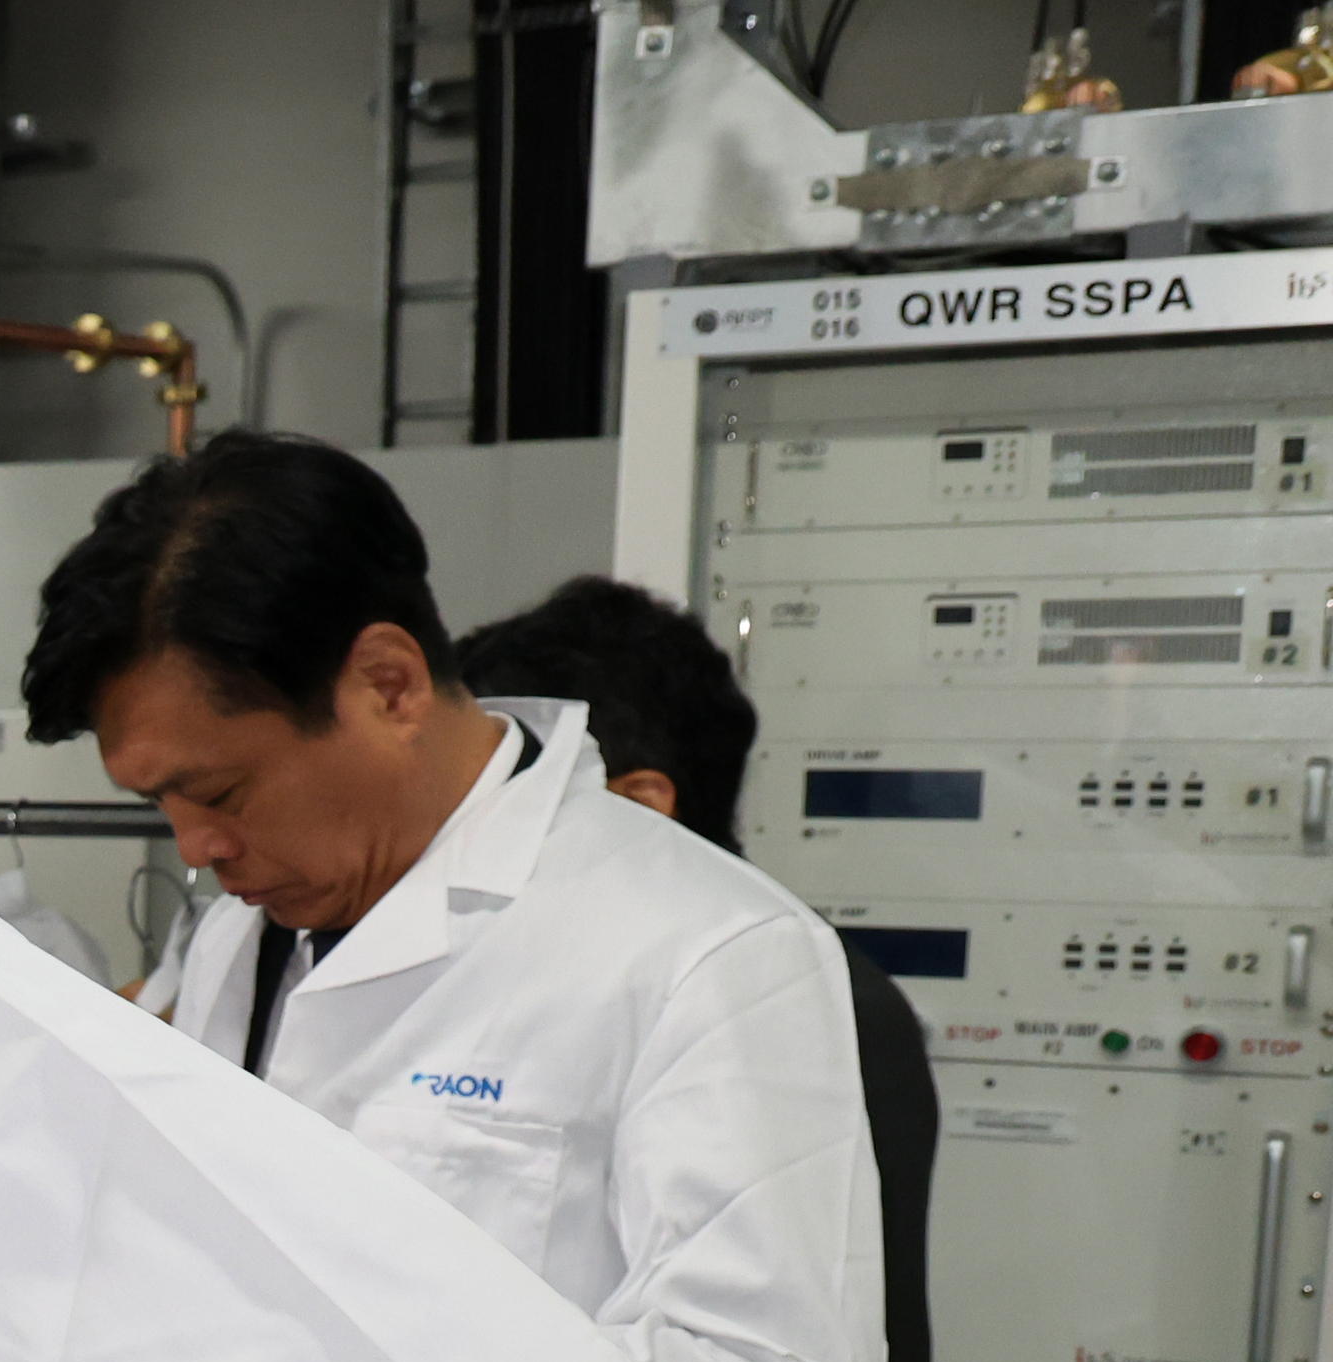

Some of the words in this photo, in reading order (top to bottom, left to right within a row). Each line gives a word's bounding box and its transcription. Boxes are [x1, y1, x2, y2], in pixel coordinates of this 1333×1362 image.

[812, 287, 863, 313] 015
[899, 286, 1021, 327] QWR
[1044, 276, 1195, 319] SSPA
[810, 316, 861, 342] 016
[1240, 1037, 1303, 1056] STOP
